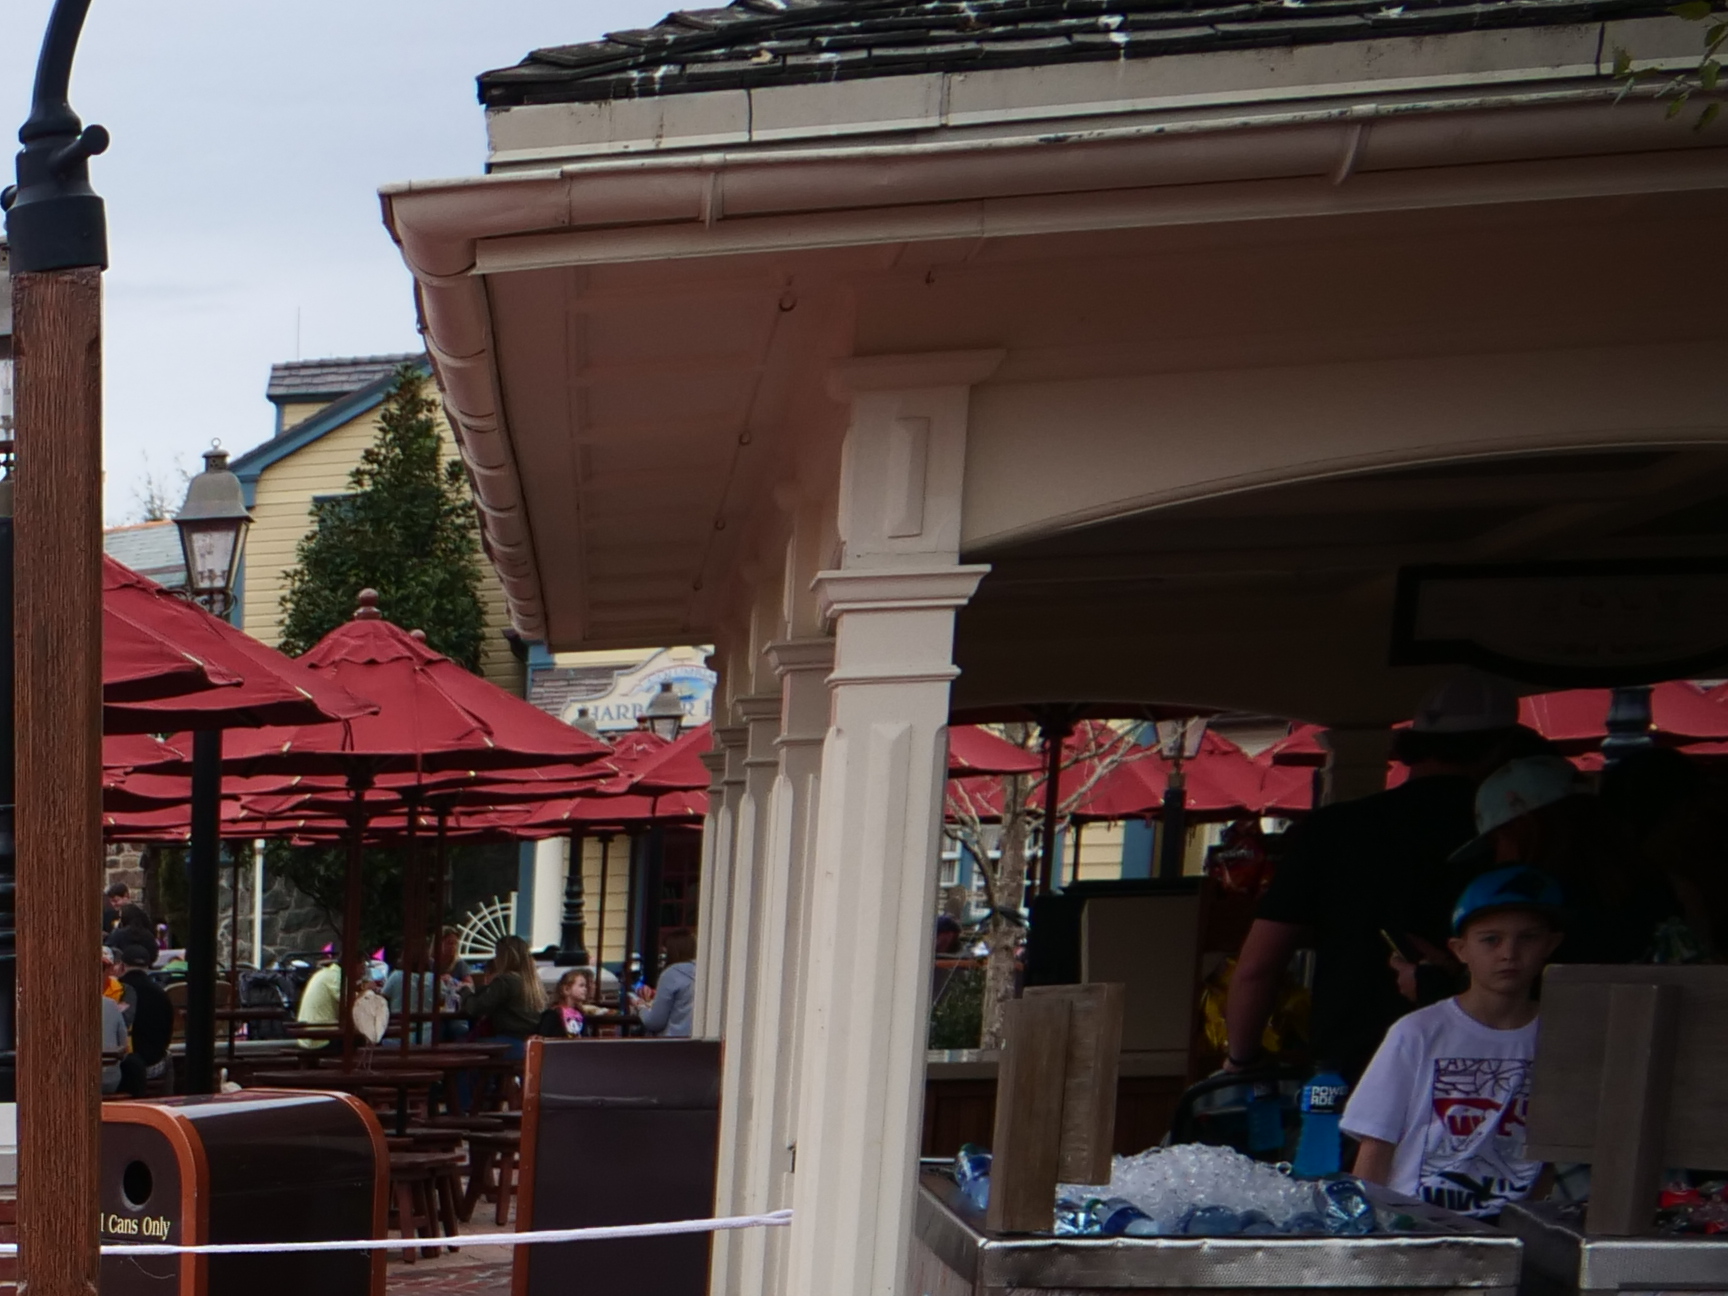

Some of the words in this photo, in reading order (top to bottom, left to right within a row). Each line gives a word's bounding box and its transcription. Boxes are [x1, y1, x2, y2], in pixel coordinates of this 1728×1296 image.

[591, 701, 694, 720] HARBR
[108, 1214, 139, 1235] Cans
[143, 1216, 171, 1241] Only
